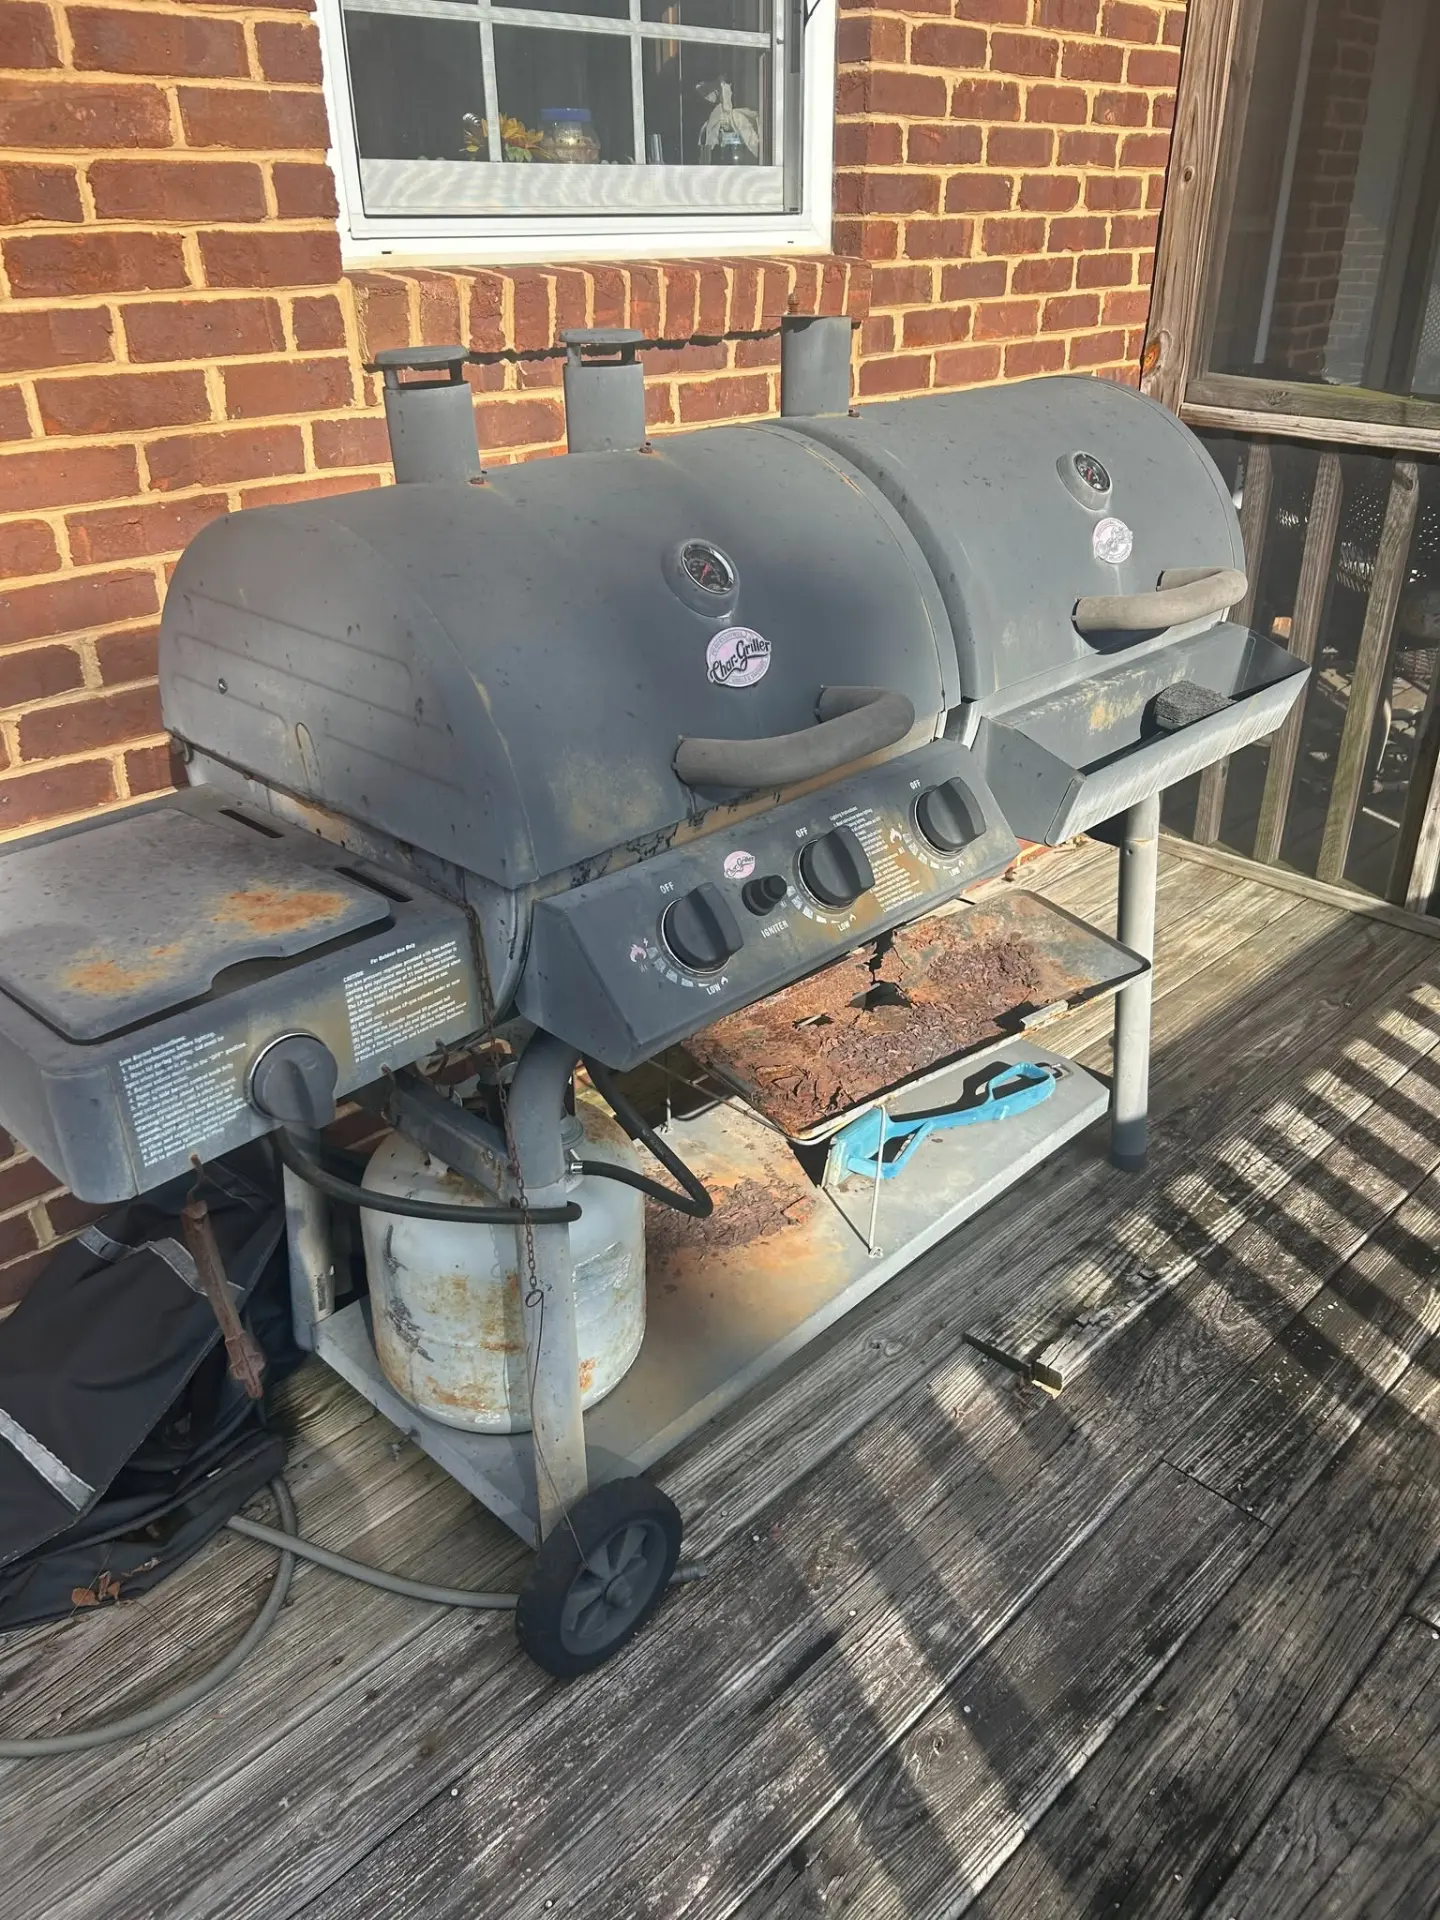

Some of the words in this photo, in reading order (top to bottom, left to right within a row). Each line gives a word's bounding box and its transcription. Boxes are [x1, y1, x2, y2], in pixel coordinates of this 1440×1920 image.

[709, 639, 770, 682] Char-Griller
[909, 780, 921, 790] OFF
[795, 827, 808, 838] OFF
[659, 881, 675, 894] OFF
[760, 919, 789, 939] IGNITER
[837, 920, 851, 932] LOW
[706, 982, 721, 996] LOW
